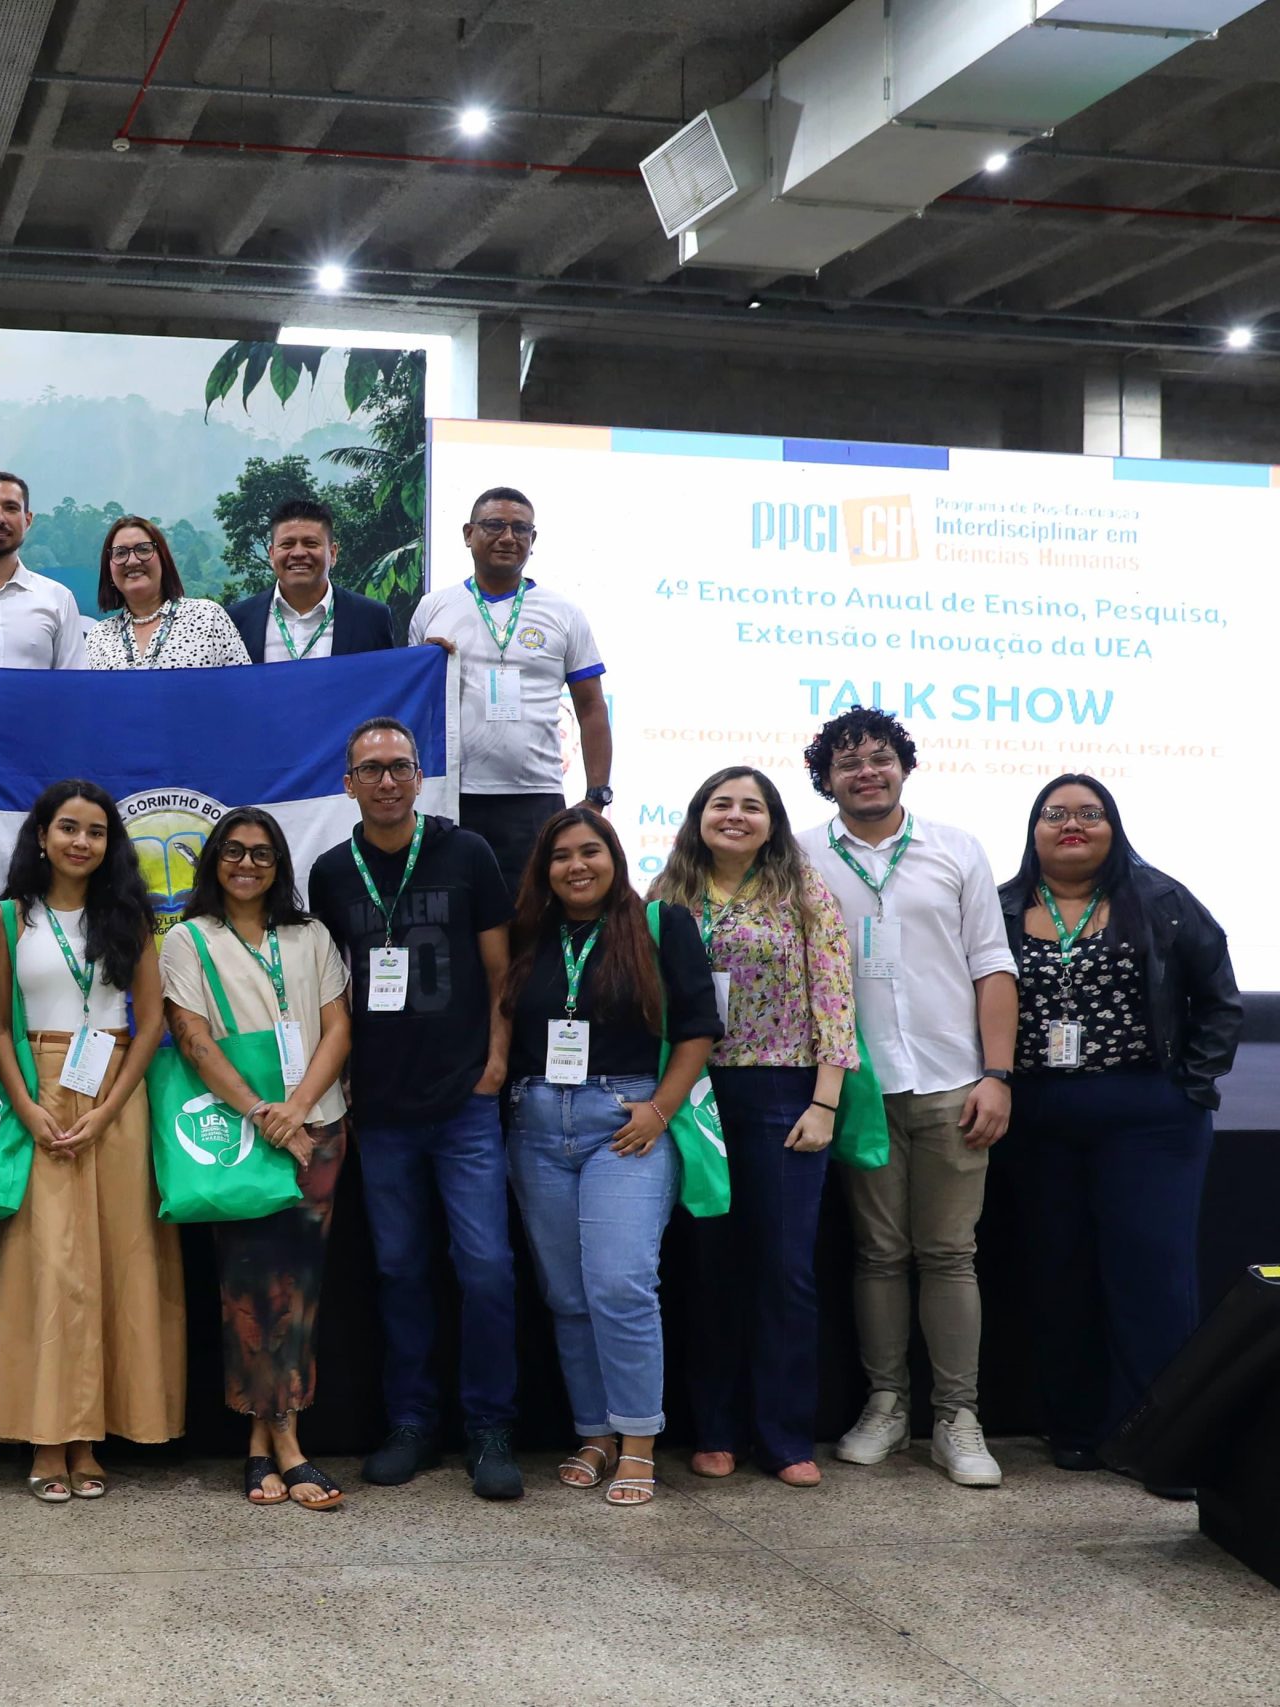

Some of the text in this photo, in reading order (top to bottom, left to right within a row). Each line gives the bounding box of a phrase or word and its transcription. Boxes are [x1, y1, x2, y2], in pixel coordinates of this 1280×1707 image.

[1010, 502, 1027, 514] de
[936, 516, 1138, 543] Interdisciplinar em
[1039, 547, 1139, 571] Humanas
[656, 578, 1227, 628] 4º Encontro Anual de Ensino, Pesquisa,
[736, 622, 1152, 659] Extensão e Inovação da UEA
[800, 679, 1114, 725] TALK SHOW
[921, 736, 1204, 756] MULTICULTURALISMO
[1211, 744, 1226, 758] E
[741, 755, 793, 768] SUA
[938, 761, 977, 773] NA
[985, 762, 1133, 778] SOCIEDADE
[127, 794, 199, 815] CORINTHO
[199, 1114, 228, 1128] UEA
